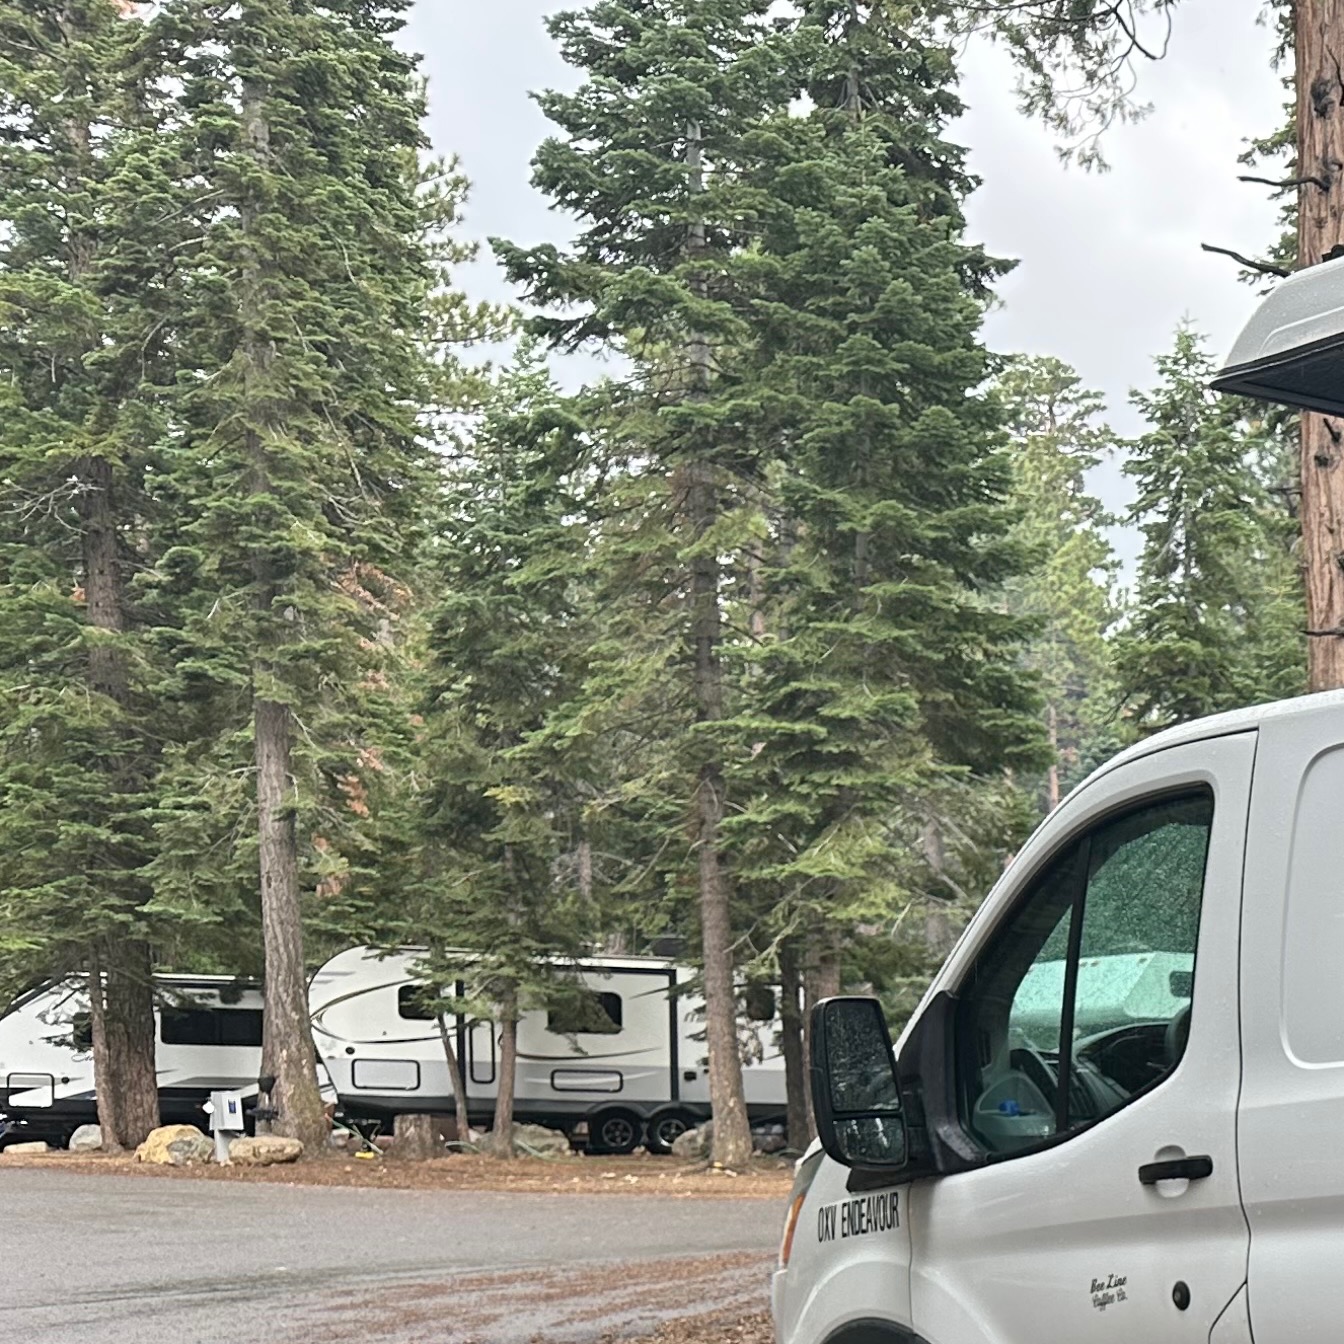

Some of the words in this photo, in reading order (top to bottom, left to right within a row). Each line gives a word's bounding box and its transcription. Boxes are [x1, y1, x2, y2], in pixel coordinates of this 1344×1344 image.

[818, 1205, 837, 1243] OXV
[841, 1192, 900, 1238] ENDEAVOUR
[1106, 1274, 1127, 1289] Line
